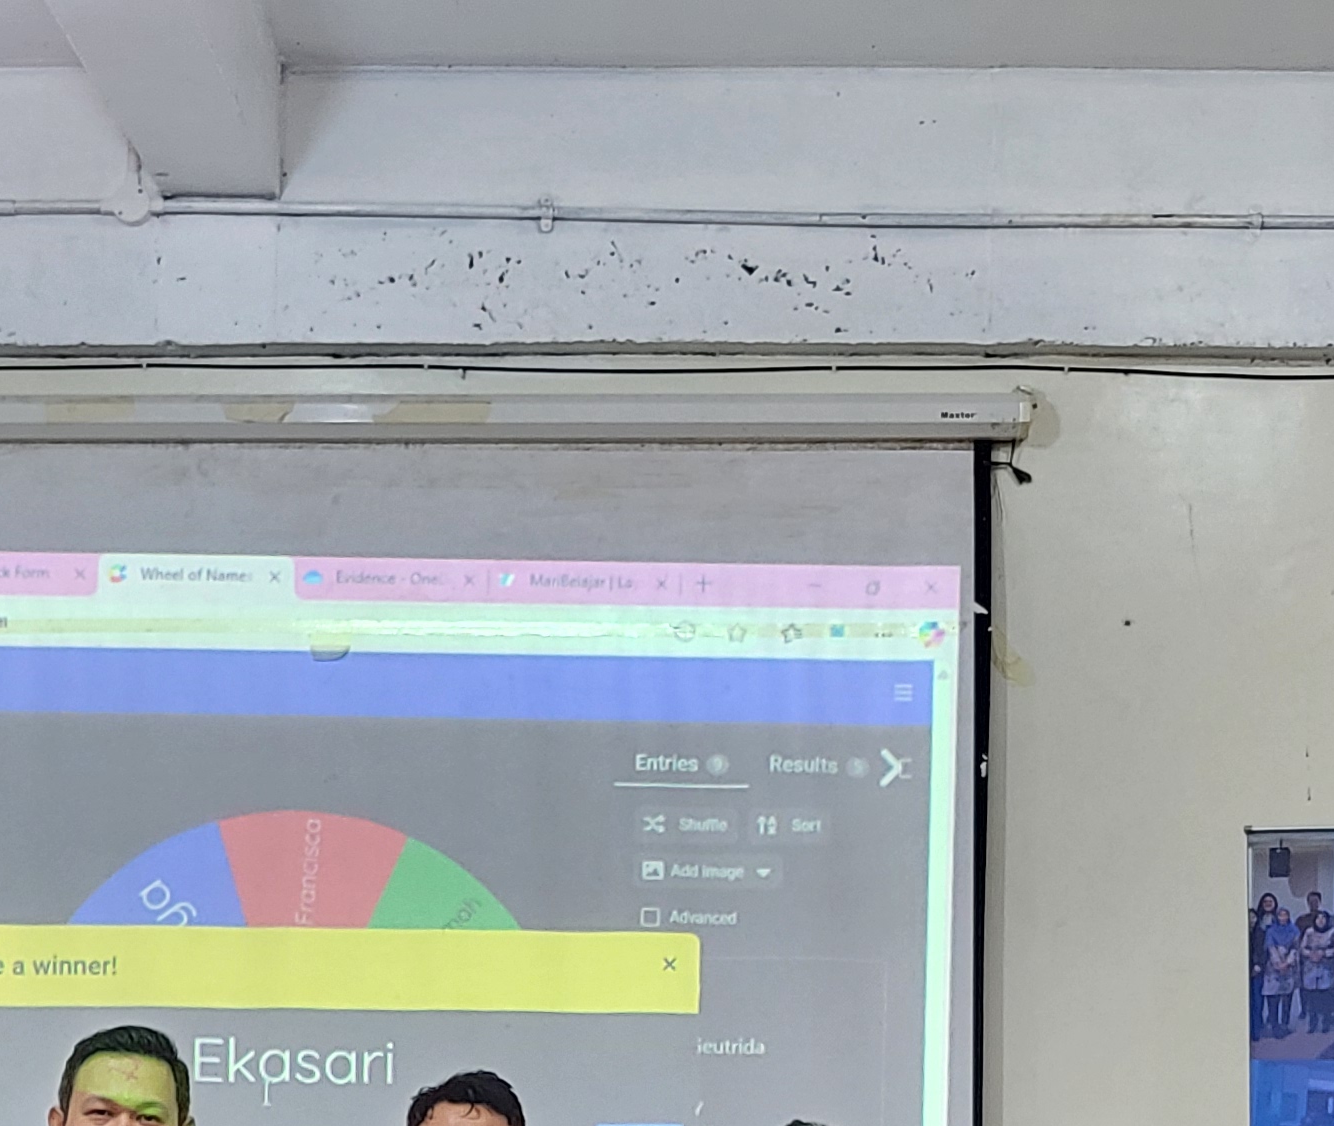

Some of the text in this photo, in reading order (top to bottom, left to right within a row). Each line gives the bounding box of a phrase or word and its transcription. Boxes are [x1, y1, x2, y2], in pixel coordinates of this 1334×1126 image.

[140, 566, 184, 581] Wheel
[188, 567, 204, 581] of
[634, 753, 699, 772] Entries
[769, 754, 838, 775] Results
[678, 817, 728, 833] Shuffle
[791, 817, 822, 833] Sort
[294, 817, 323, 927] Francisca
[670, 863, 745, 882] Add image
[669, 909, 738, 926] Advanced
[11, 961, 25, 976] a
[32, 956, 118, 977] winner!
[192, 1036, 396, 1085] Ekasari
